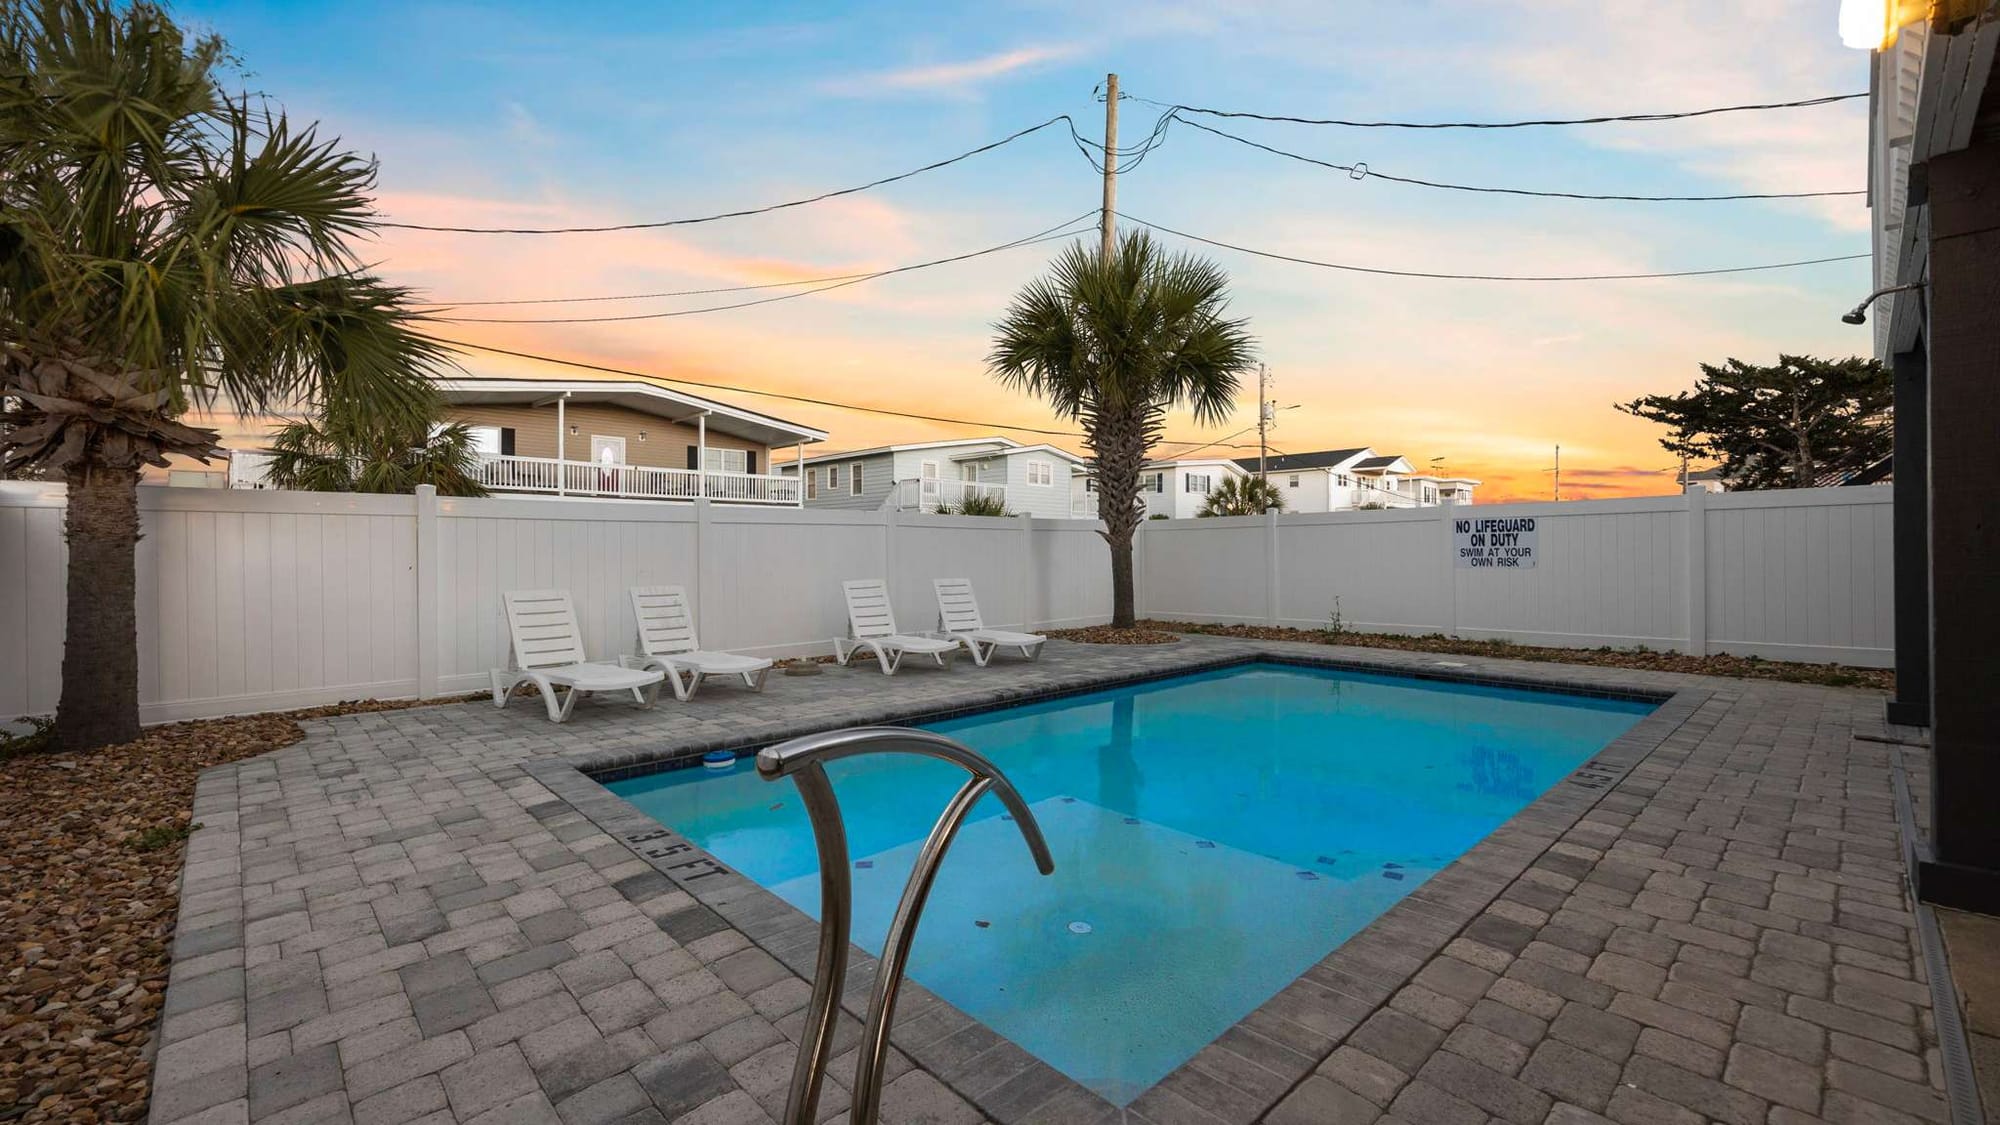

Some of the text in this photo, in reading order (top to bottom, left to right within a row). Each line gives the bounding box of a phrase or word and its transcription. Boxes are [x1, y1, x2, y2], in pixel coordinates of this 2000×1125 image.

[1456, 518, 1535, 533] NO LIFEGUARD
[1470, 532, 1519, 547] ON DUTY
[1460, 547, 1532, 557] SWIM AT YOUR
[1471, 557, 1519, 567] OWN RISK
[1584, 760, 1626, 774] FT
[667, 859, 729, 881] FT
